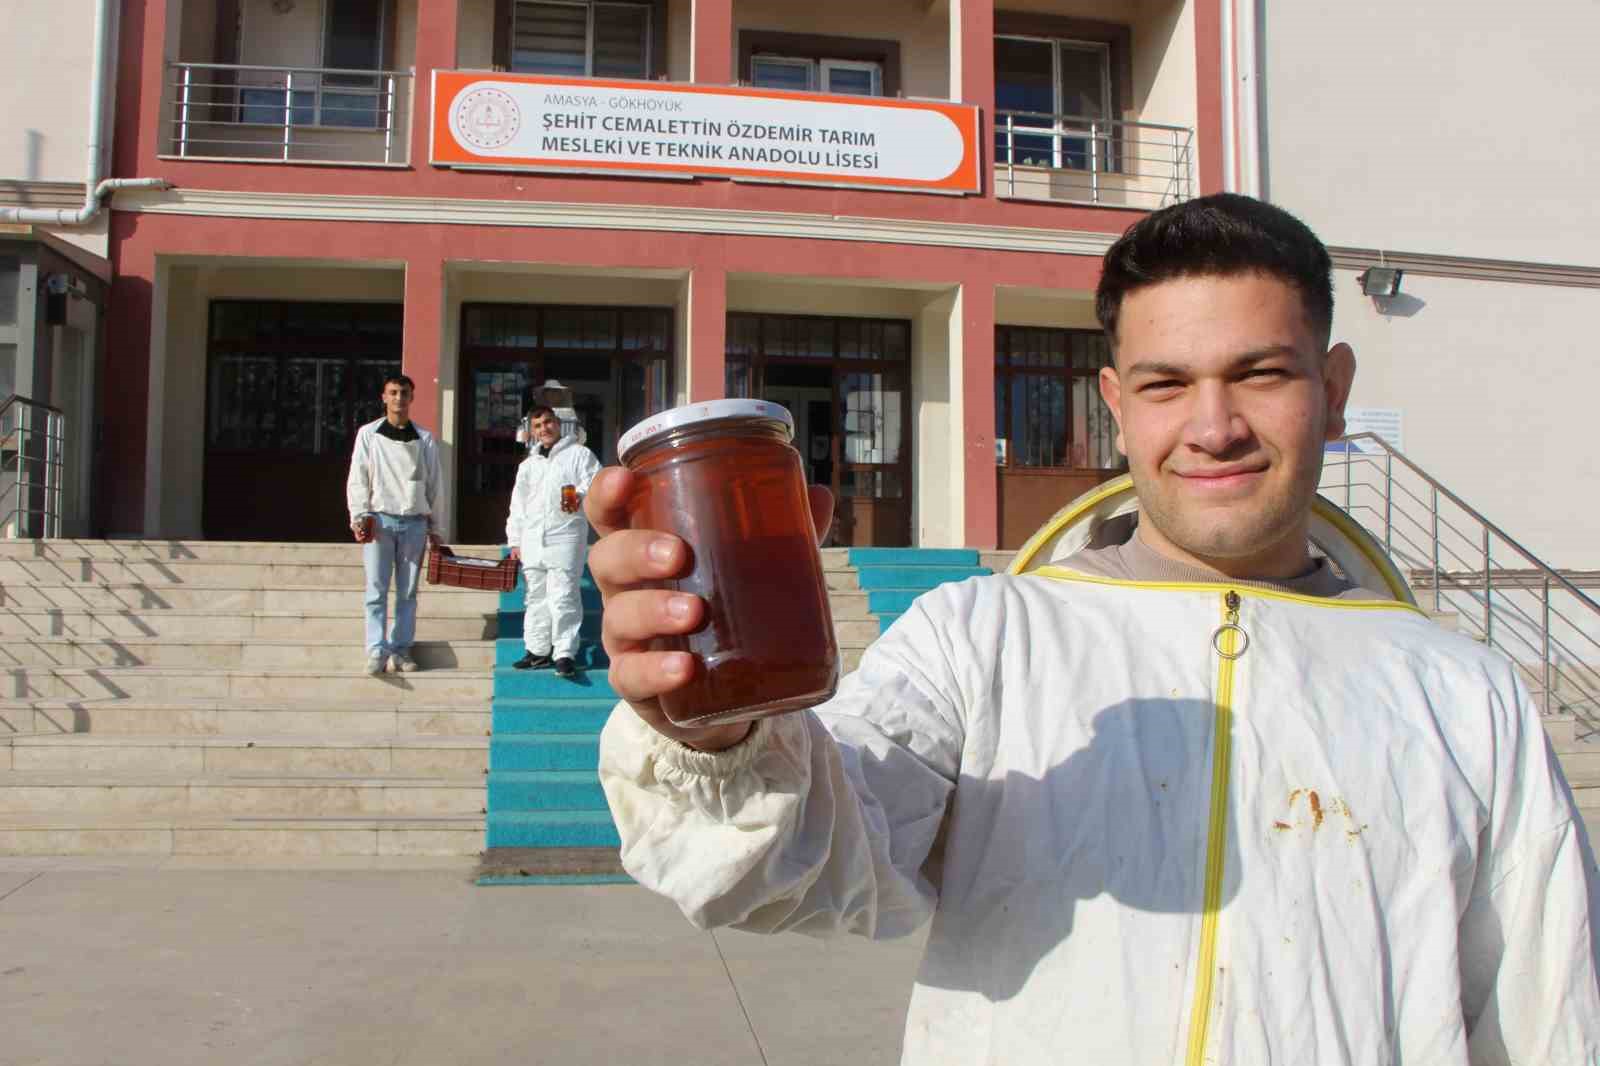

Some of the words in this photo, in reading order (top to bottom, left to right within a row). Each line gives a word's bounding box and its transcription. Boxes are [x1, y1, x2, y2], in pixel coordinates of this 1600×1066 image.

[544, 94, 598, 107] AMASYA
[543, 112, 597, 131] ŞEHİT
[602, 116, 720, 137] CEMALETTİN
[727, 120, 812, 142] ÖZDEMİR
[819, 129, 875, 146] TARIM
[542, 135, 623, 155] MESLEKİ
[628, 140, 651, 155] VE
[656, 141, 723, 159] TEKNİK
[728, 147, 820, 165] ANADOLU
[826, 149, 879, 169] LİSESİ
